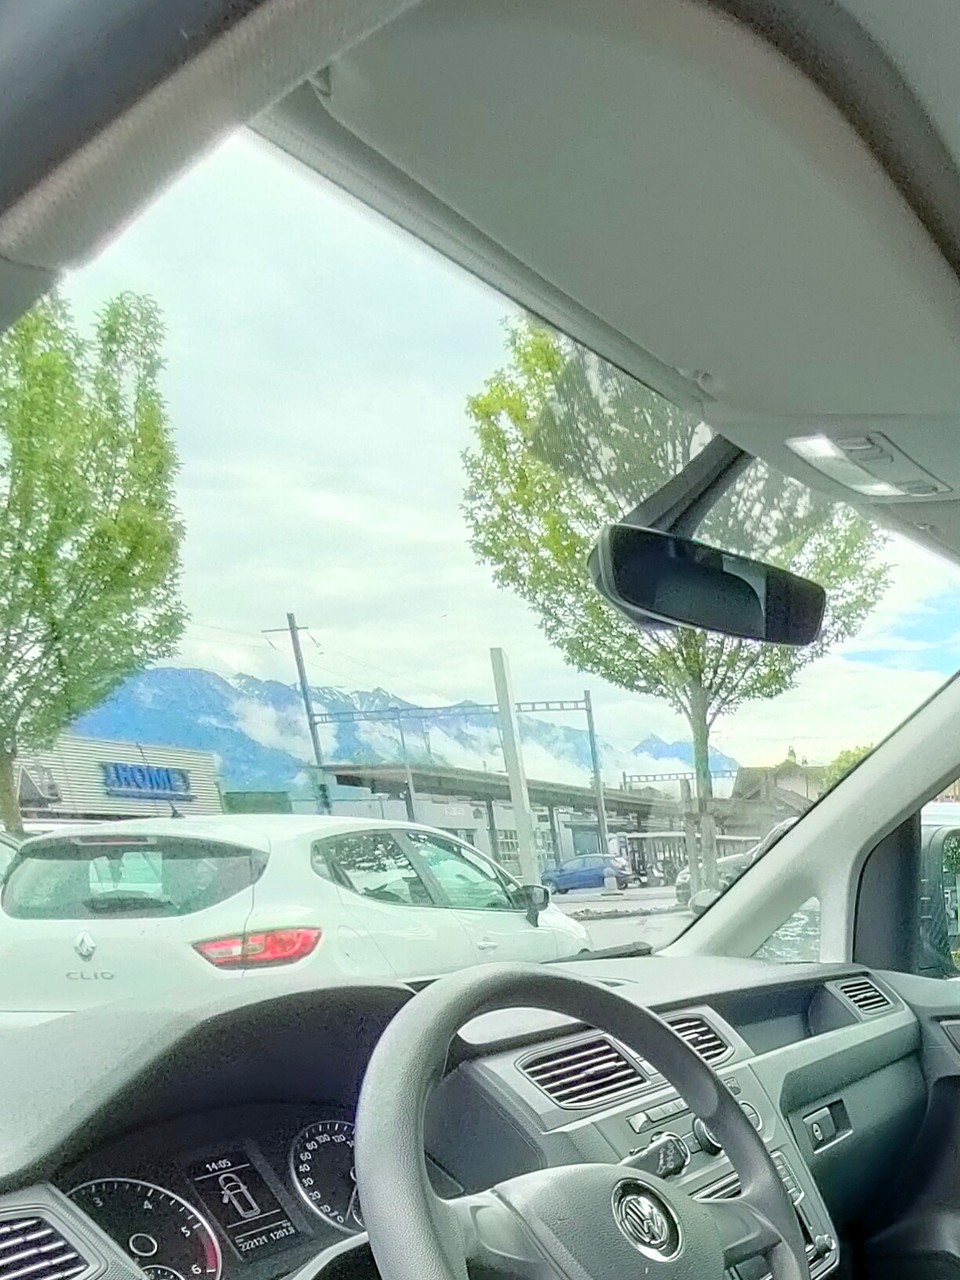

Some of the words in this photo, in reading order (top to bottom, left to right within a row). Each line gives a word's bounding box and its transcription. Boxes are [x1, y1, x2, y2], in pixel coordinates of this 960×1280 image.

[65, 971, 115, 980] CLIO
[315, 1133, 331, 1144] 100
[331, 1134, 346, 1143] 120
[305, 1141, 318, 1151] 80
[299, 1151, 312, 1161] 60
[205, 1159, 232, 1172] 14:05
[298, 1163, 311, 1173] 40
[301, 1177, 314, 1187] 30
[308, 1190, 321, 1200] 20
[92, 1197, 103, 1208] 3
[143, 1200, 153, 1210] 4
[180, 1226, 192, 1238] 5
[191, 1264, 202, 1275] 6
